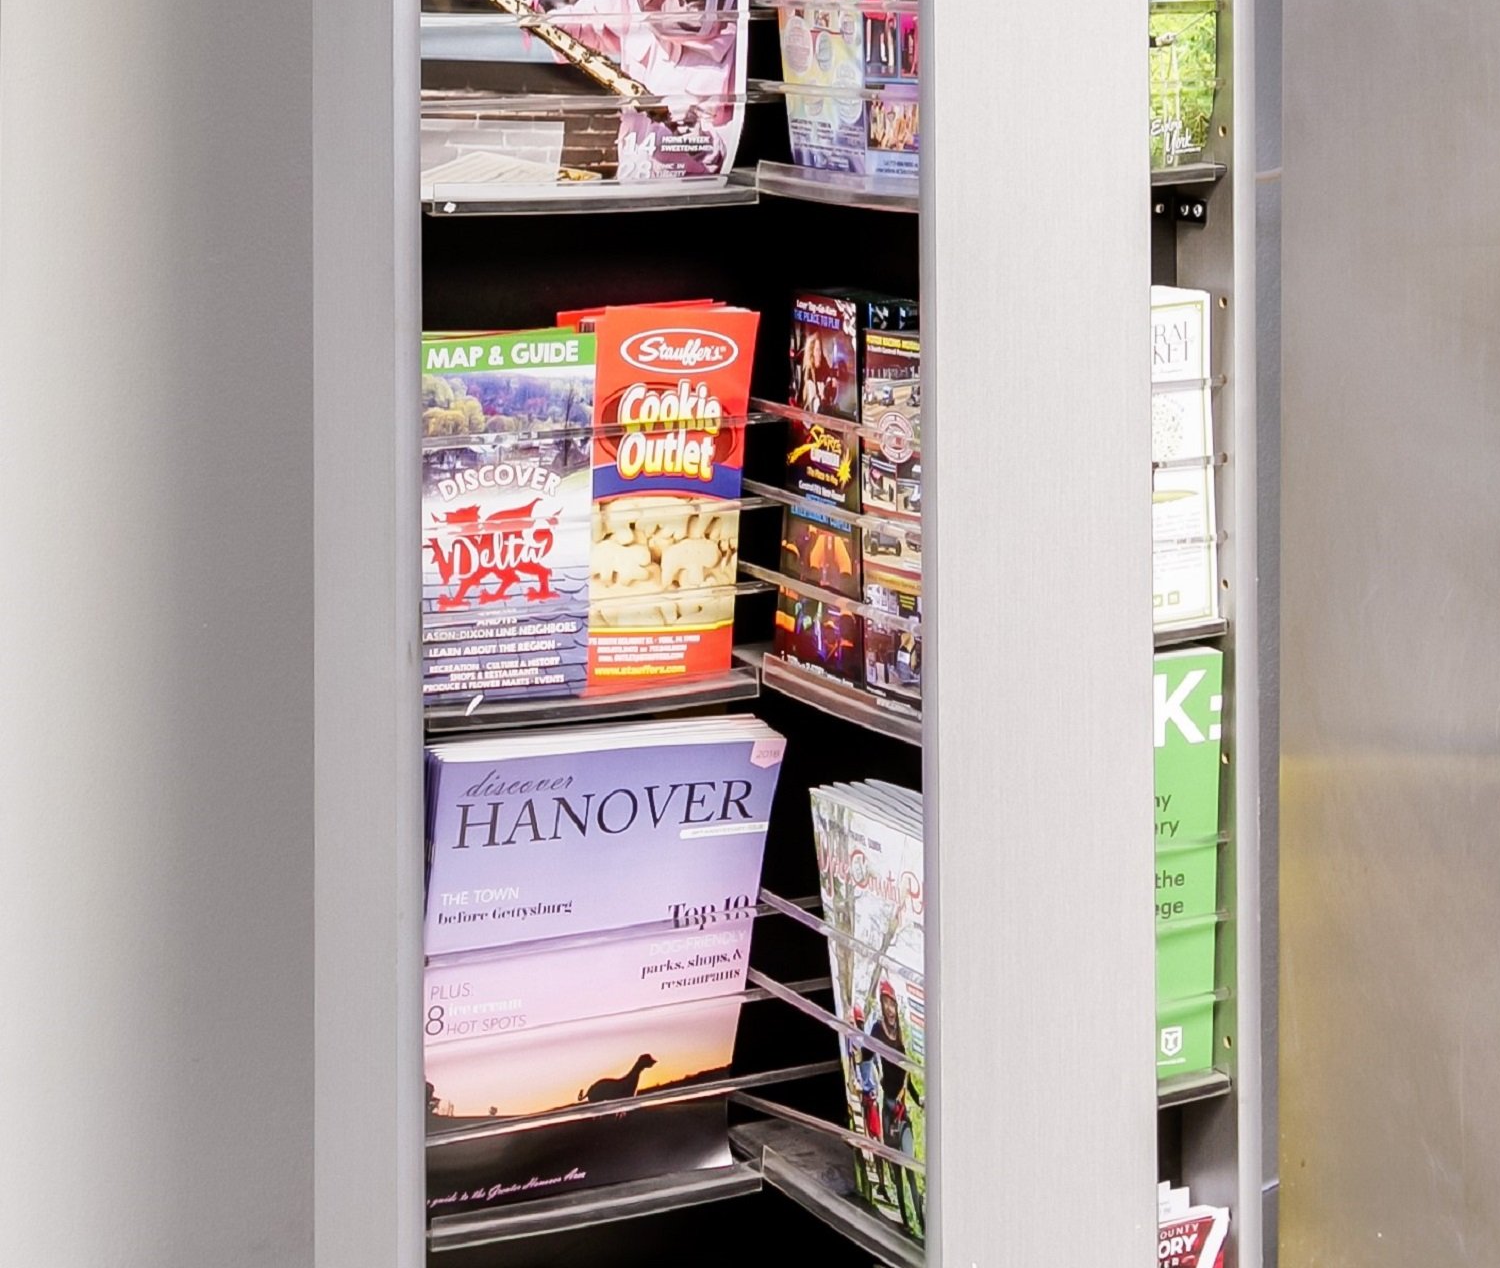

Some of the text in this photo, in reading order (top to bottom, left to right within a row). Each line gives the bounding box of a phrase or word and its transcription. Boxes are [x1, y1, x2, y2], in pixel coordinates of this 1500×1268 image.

[623, 131, 657, 157] 14
[426, 339, 579, 370] MAP & GUIDE
[637, 335, 722, 366] Stauffer's
[617, 378, 722, 436] Cookie
[616, 428, 716, 482] Outlet
[437, 463, 562, 502] DISCOVER
[451, 530, 550, 580] Delta
[423, 621, 577, 642] ASON-DIXON LINE NEIGHBORS
[429, 640, 556, 658] LEARN ABOUT THE REGION
[534, 674, 565, 685] EVENTS
[460, 769, 573, 799] discover
[452, 779, 754, 850] HANOVER
[1155, 820, 1180, 838] ry
[1155, 870, 1185, 890] the
[441, 887, 520, 906] THE TOWN
[438, 899, 574, 925] before Gettysburg
[668, 894, 750, 931] Top 10
[641, 959, 685, 980] parks,
[687, 951, 731, 968] shops,
[660, 968, 741, 990] restaurants
[425, 1004, 445, 1036] 8
[446, 1014, 527, 1036] HOT SPOTS
[1158, 1233, 1199, 1259] ORY
